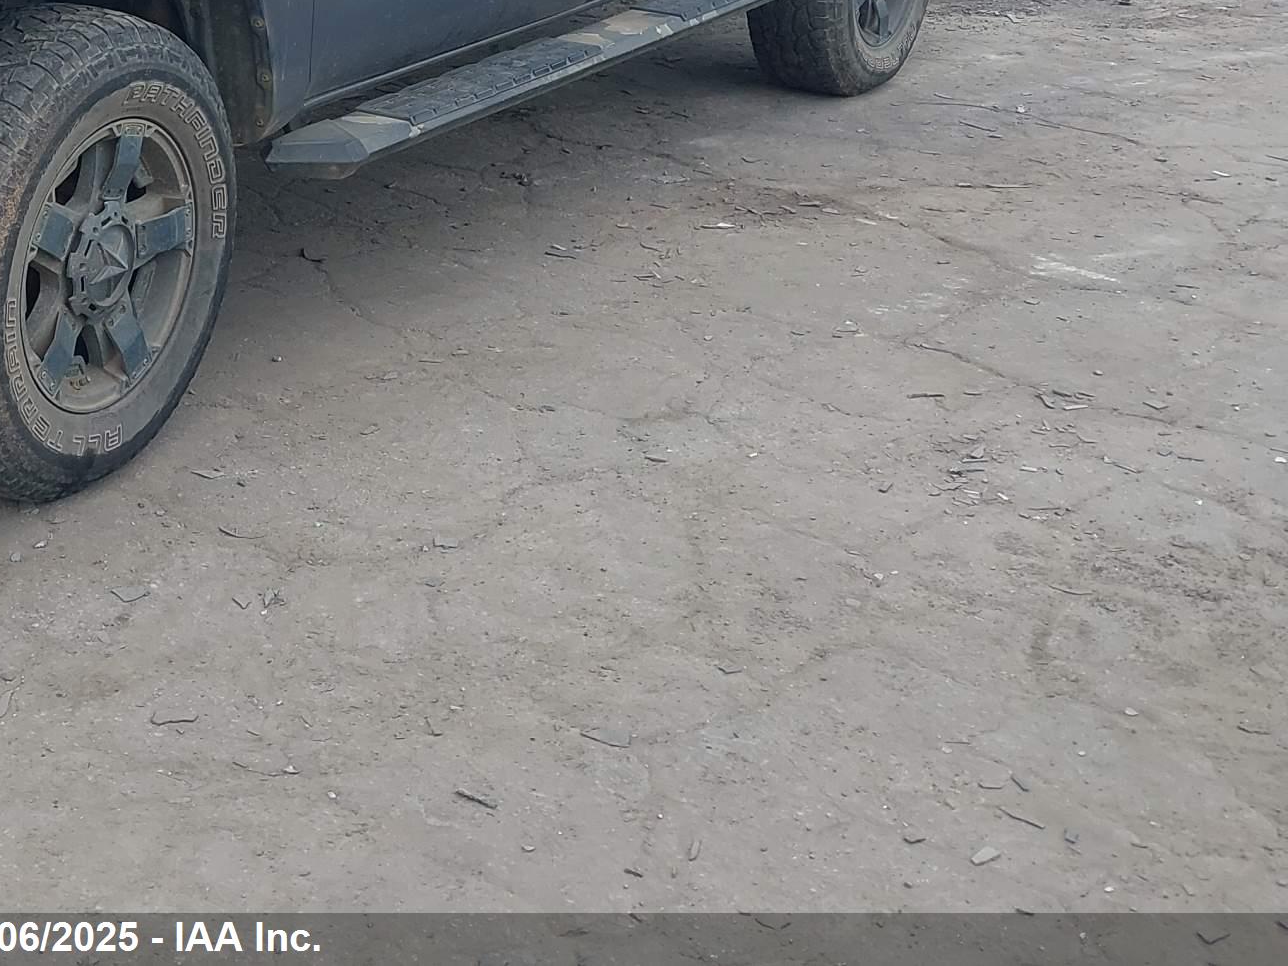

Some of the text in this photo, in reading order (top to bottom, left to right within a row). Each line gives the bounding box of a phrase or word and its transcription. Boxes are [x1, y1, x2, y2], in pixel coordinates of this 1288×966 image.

[122, 82, 228, 239] PATHFINDER
[5, 298, 123, 456] ALL TERRAIN
